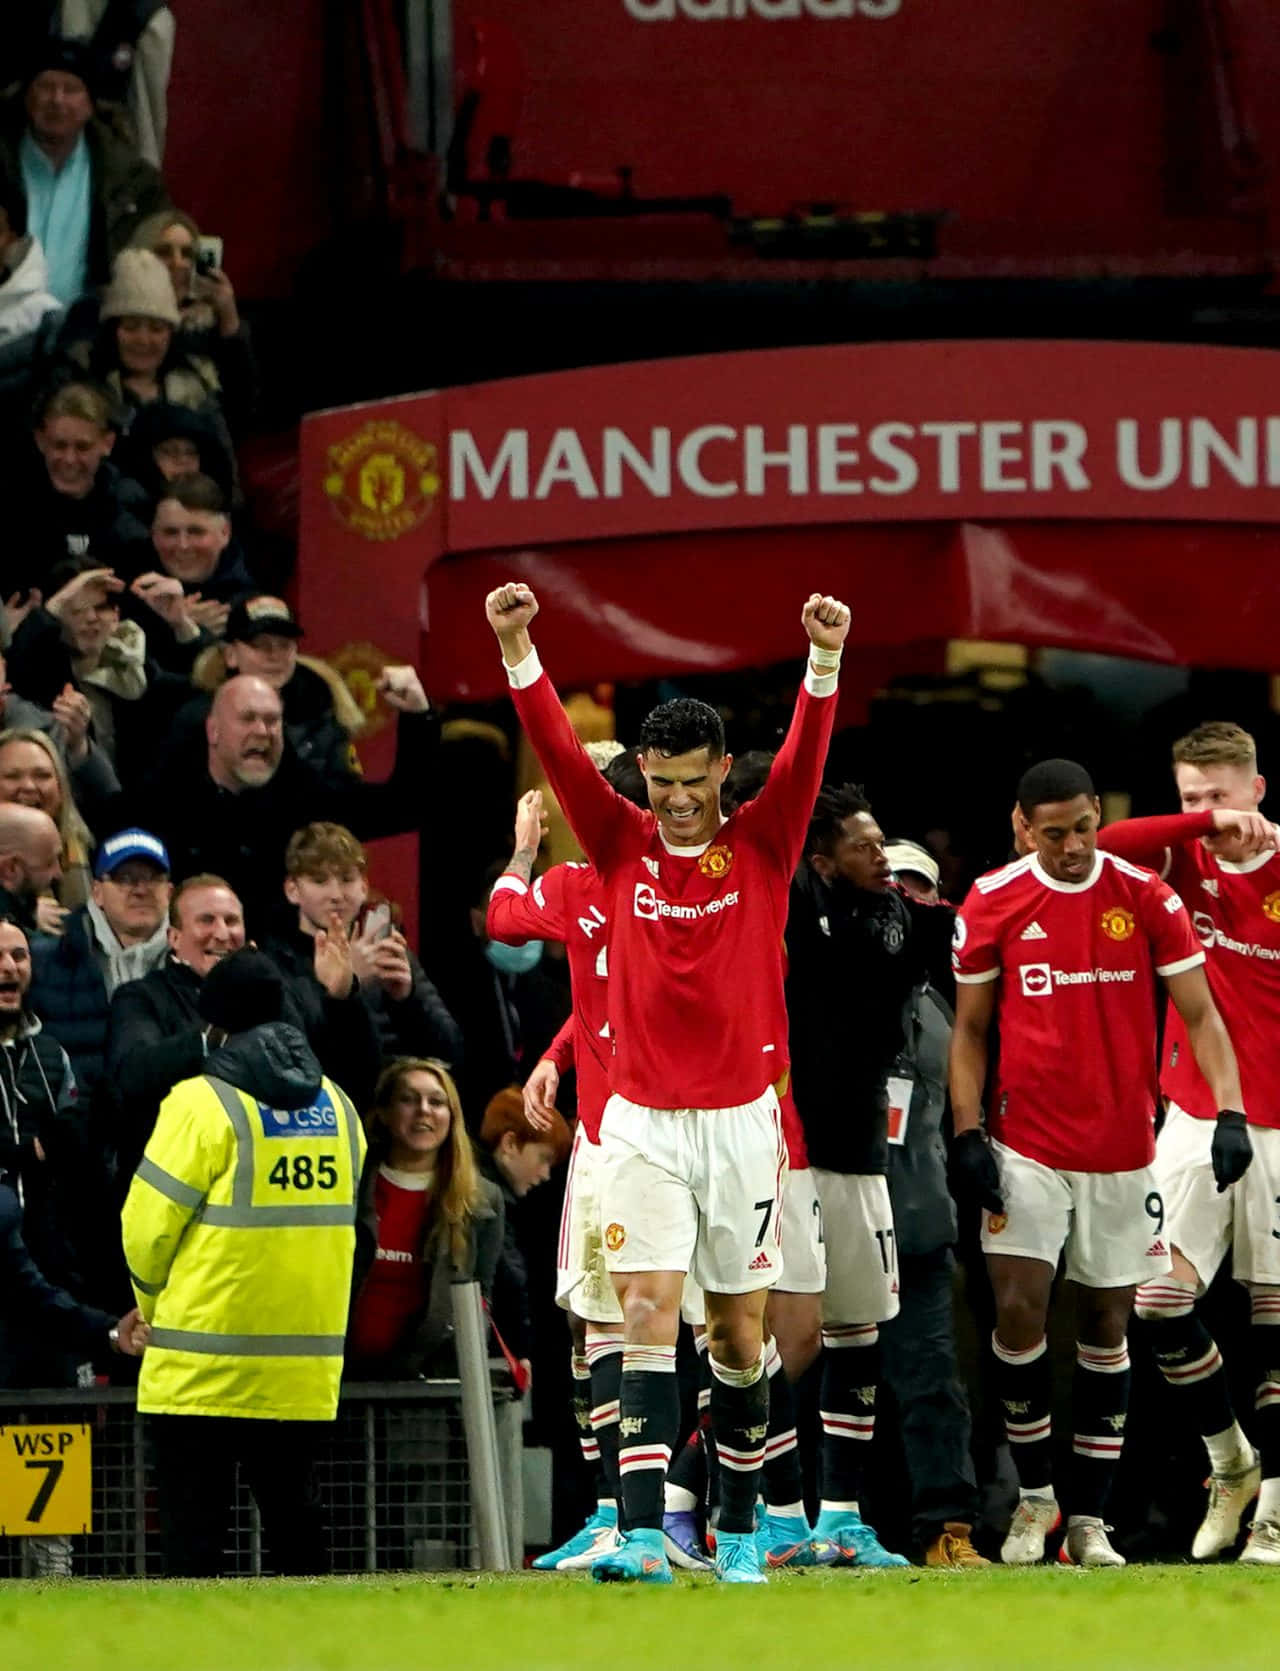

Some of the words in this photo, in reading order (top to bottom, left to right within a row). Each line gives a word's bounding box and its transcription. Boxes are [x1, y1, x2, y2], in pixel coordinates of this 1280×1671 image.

[450, 420, 1092, 500] MANCHESTER
[1052, 968, 1136, 985] TeamViewer
[294, 1106, 336, 1127] CSG
[269, 1155, 338, 1190] 485
[754, 1198, 775, 1247] 7
[1145, 1192, 1164, 1236] 9
[13, 1432, 74, 1456] WSP
[25, 1460, 64, 1523] 7
